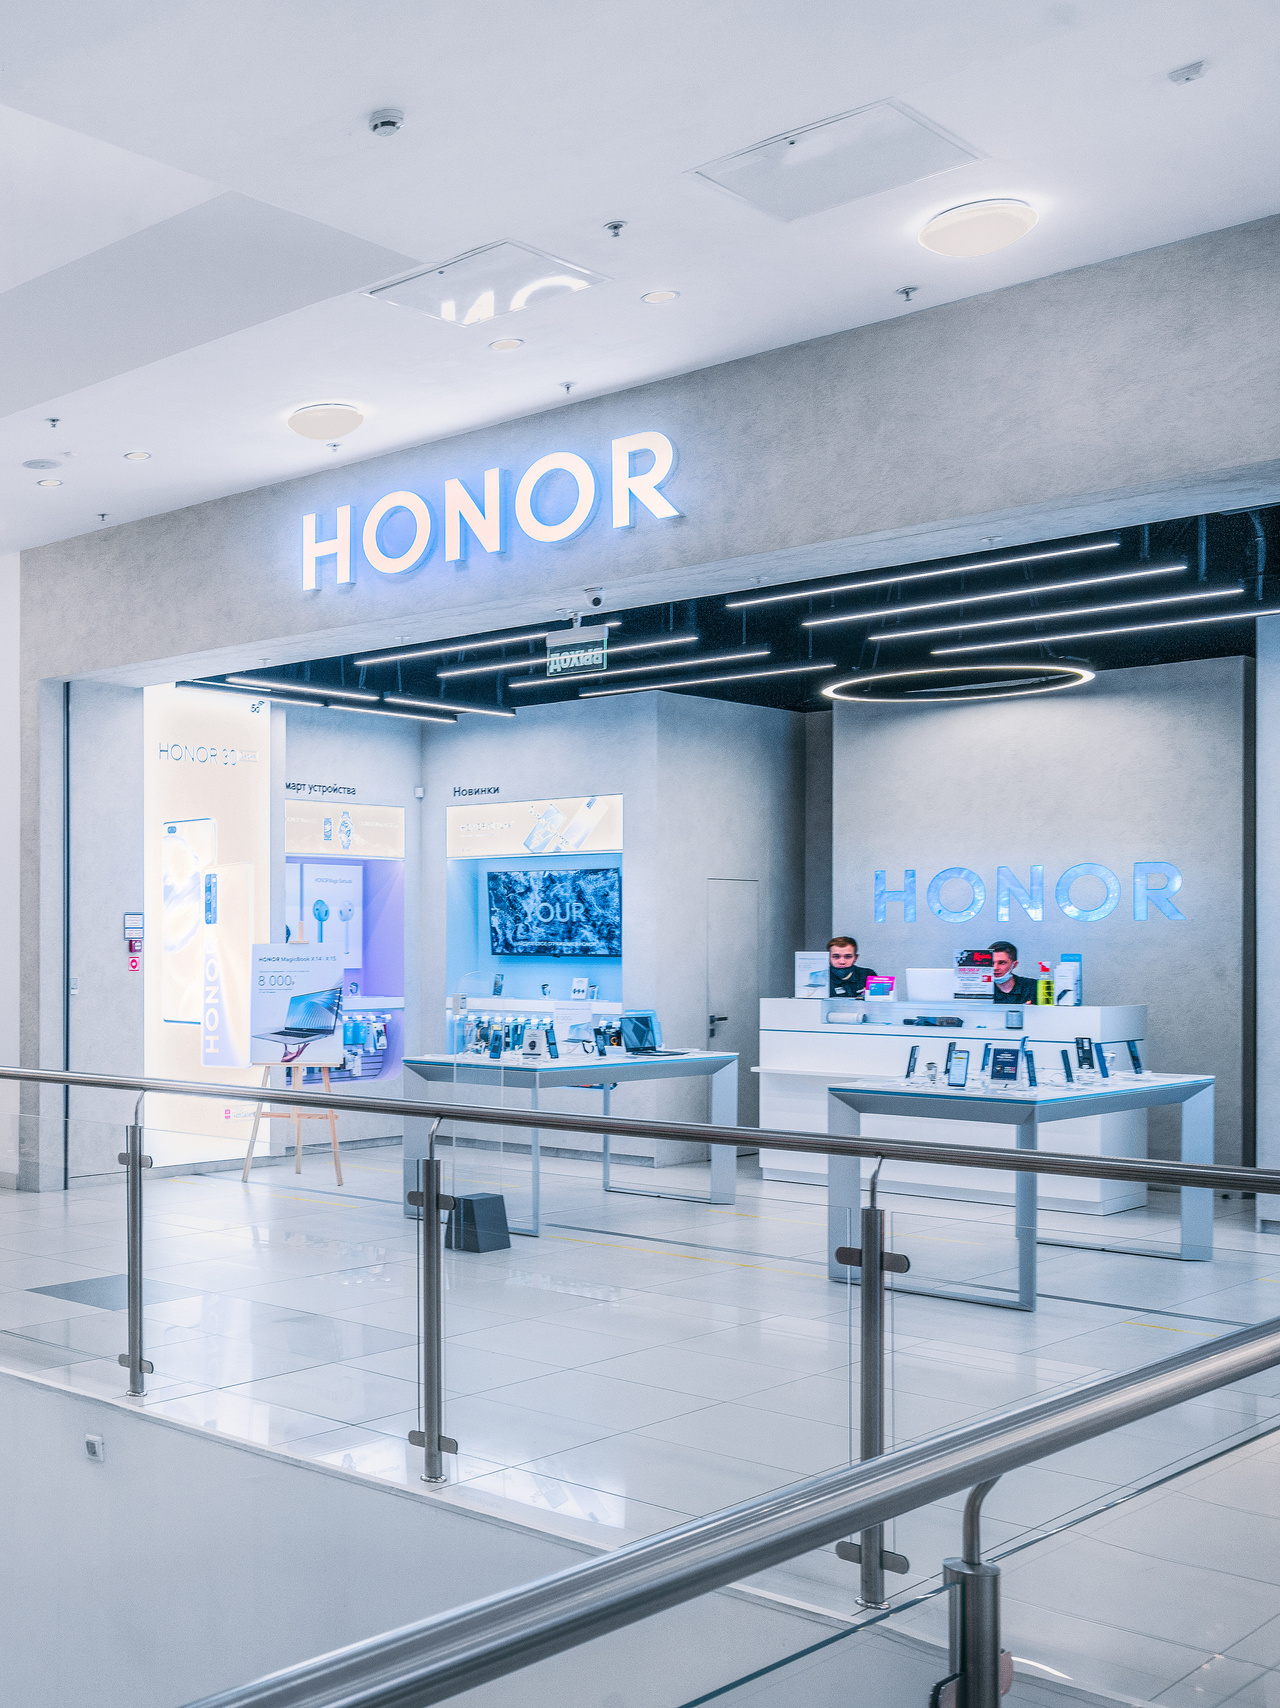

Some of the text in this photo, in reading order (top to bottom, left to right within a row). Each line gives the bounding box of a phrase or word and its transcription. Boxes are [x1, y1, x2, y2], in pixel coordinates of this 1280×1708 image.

[302, 431, 682, 592] HONOR
[159, 743, 218, 764] HONOR
[221, 748, 237, 766] 30
[285, 782, 356, 796] март устройства
[453, 786, 500, 797] Новинки
[874, 862, 1187, 923] HONOR
[522, 902, 585, 922] YOUR
[205, 947, 219, 1053] HONO
